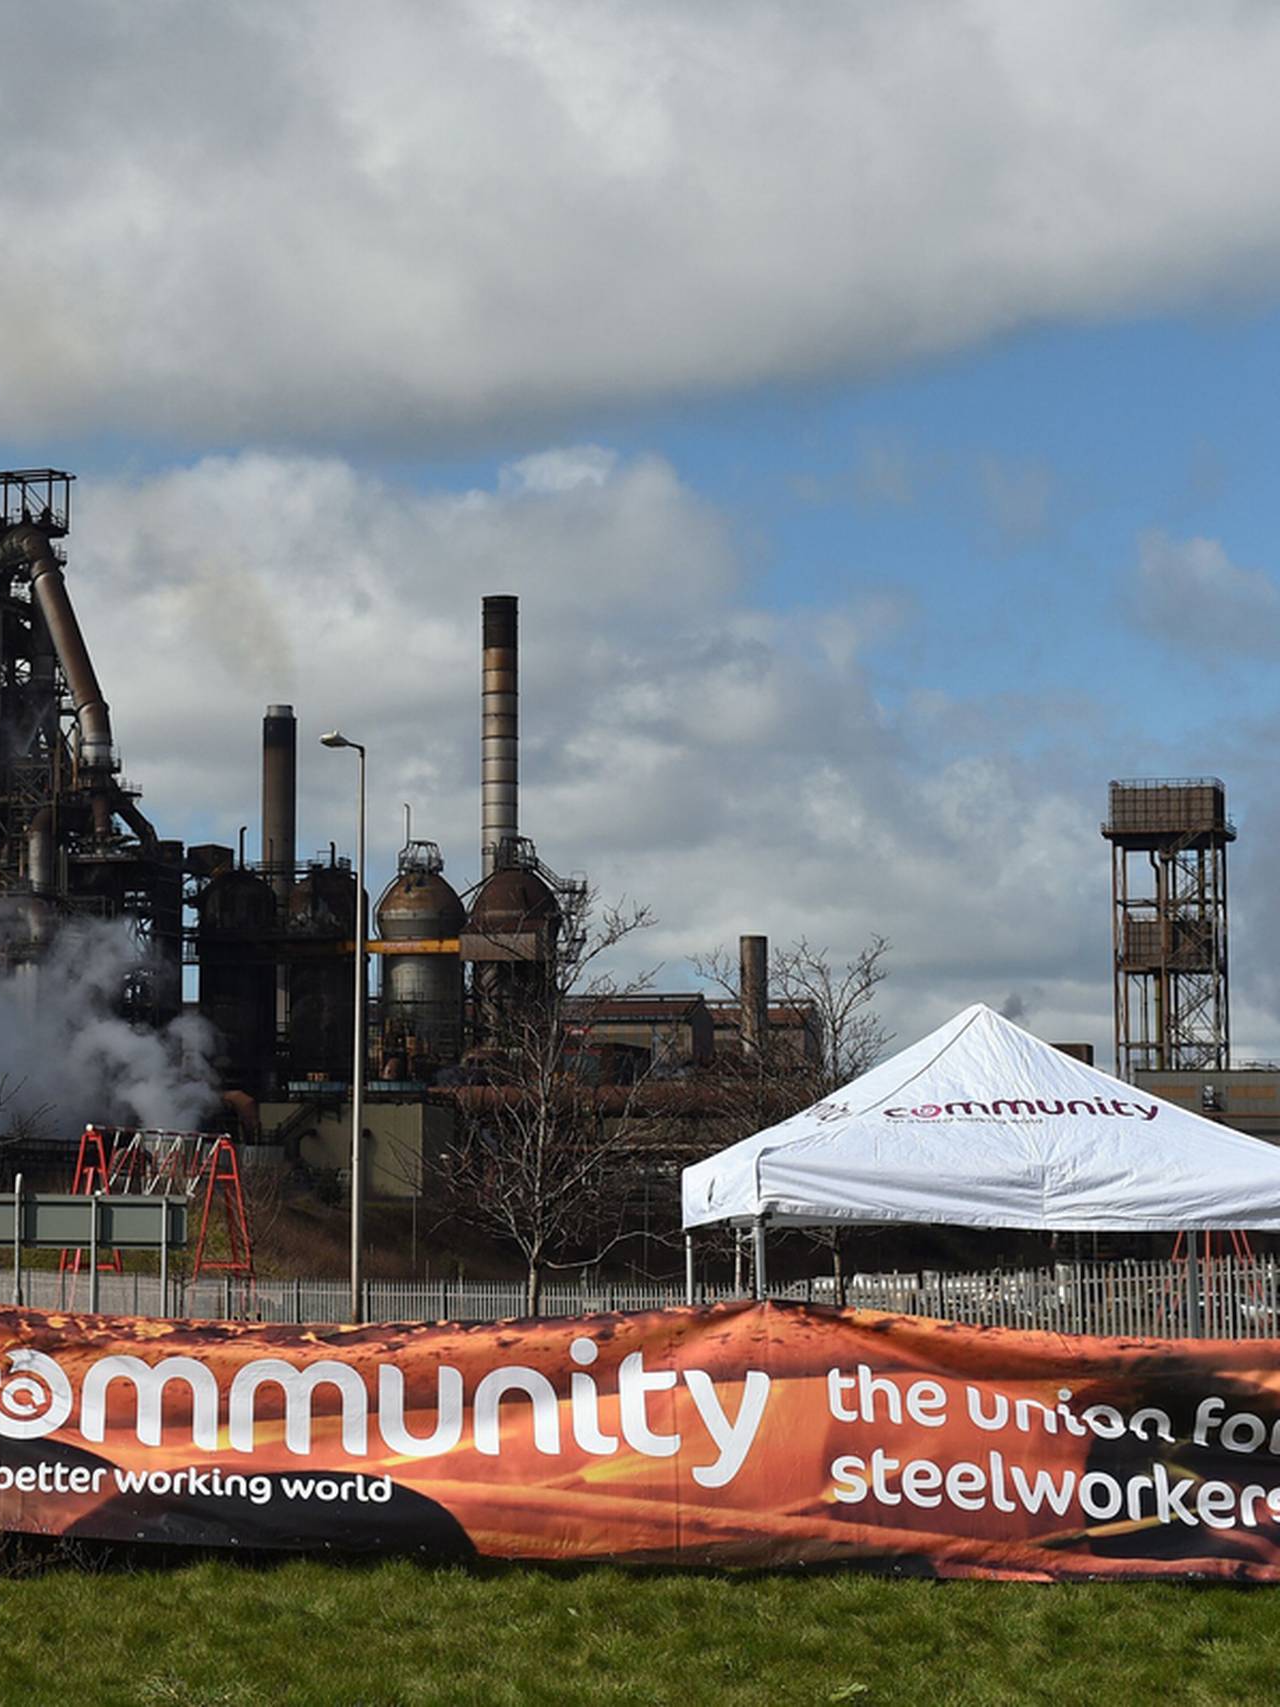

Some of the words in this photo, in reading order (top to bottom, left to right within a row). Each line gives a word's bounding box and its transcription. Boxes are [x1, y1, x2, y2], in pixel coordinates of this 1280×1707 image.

[883, 1096, 1159, 1121] community
[827, 1363, 947, 1427] the
[966, 1386, 1176, 1444] union
[113, 1466, 273, 1505] working
[280, 1474, 392, 1503] world
